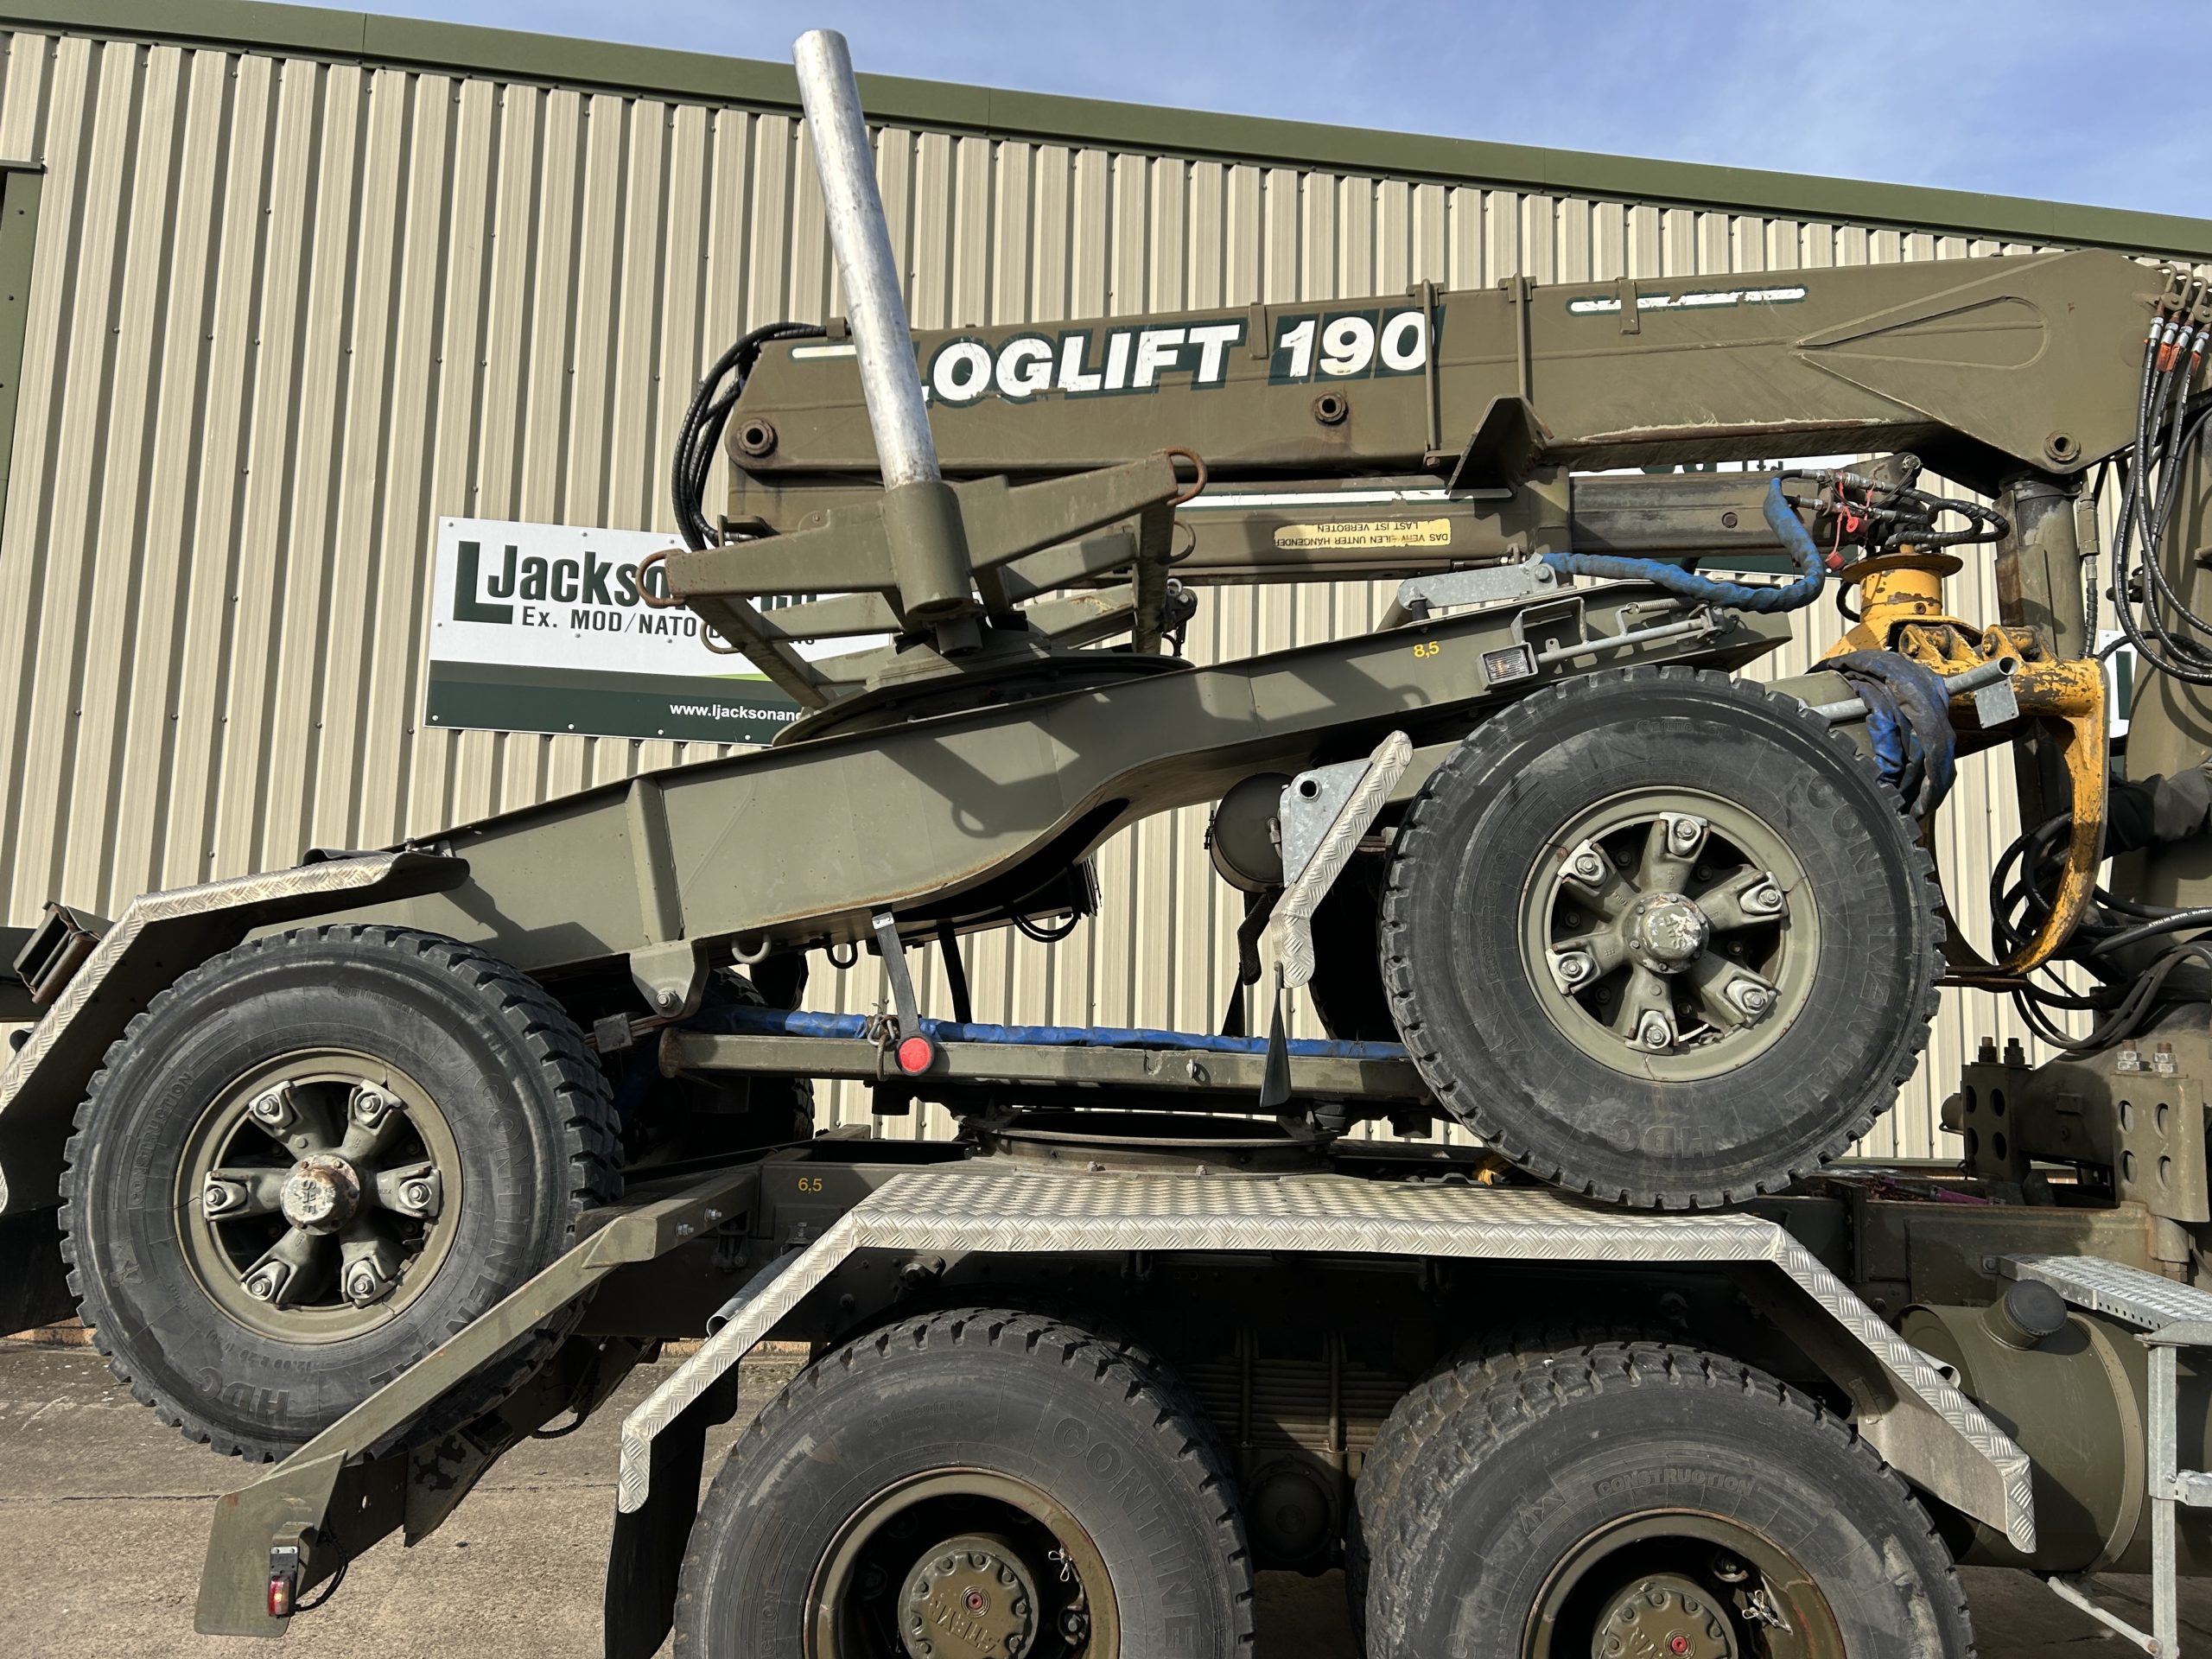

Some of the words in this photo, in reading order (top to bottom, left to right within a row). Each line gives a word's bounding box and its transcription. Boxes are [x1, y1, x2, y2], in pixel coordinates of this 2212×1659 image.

[919, 324, 1241, 401] OGLIFT
[1280, 311, 1434, 378] 190
[1317, 523, 1370, 533] VERBOTEN
[1374, 522, 1389, 531] IST
[1393, 521, 1419, 531] LAST
[1334, 536, 1366, 545] UNTER
[1429, 532, 1448, 542] DAS
[522, 606, 557, 628] Ex.
[570, 607, 697, 637] MOD/NATO
[1413, 640, 1440, 658] 8,5
[130, 1072, 193, 1205] CONSTRUCTION
[1607, 1119, 1715, 1158] HDC
[798, 1177, 823, 1194] 6,5
[193, 1365, 289, 1424] HDC
[1598, 1468, 1755, 1498] CONSTRUCTION
